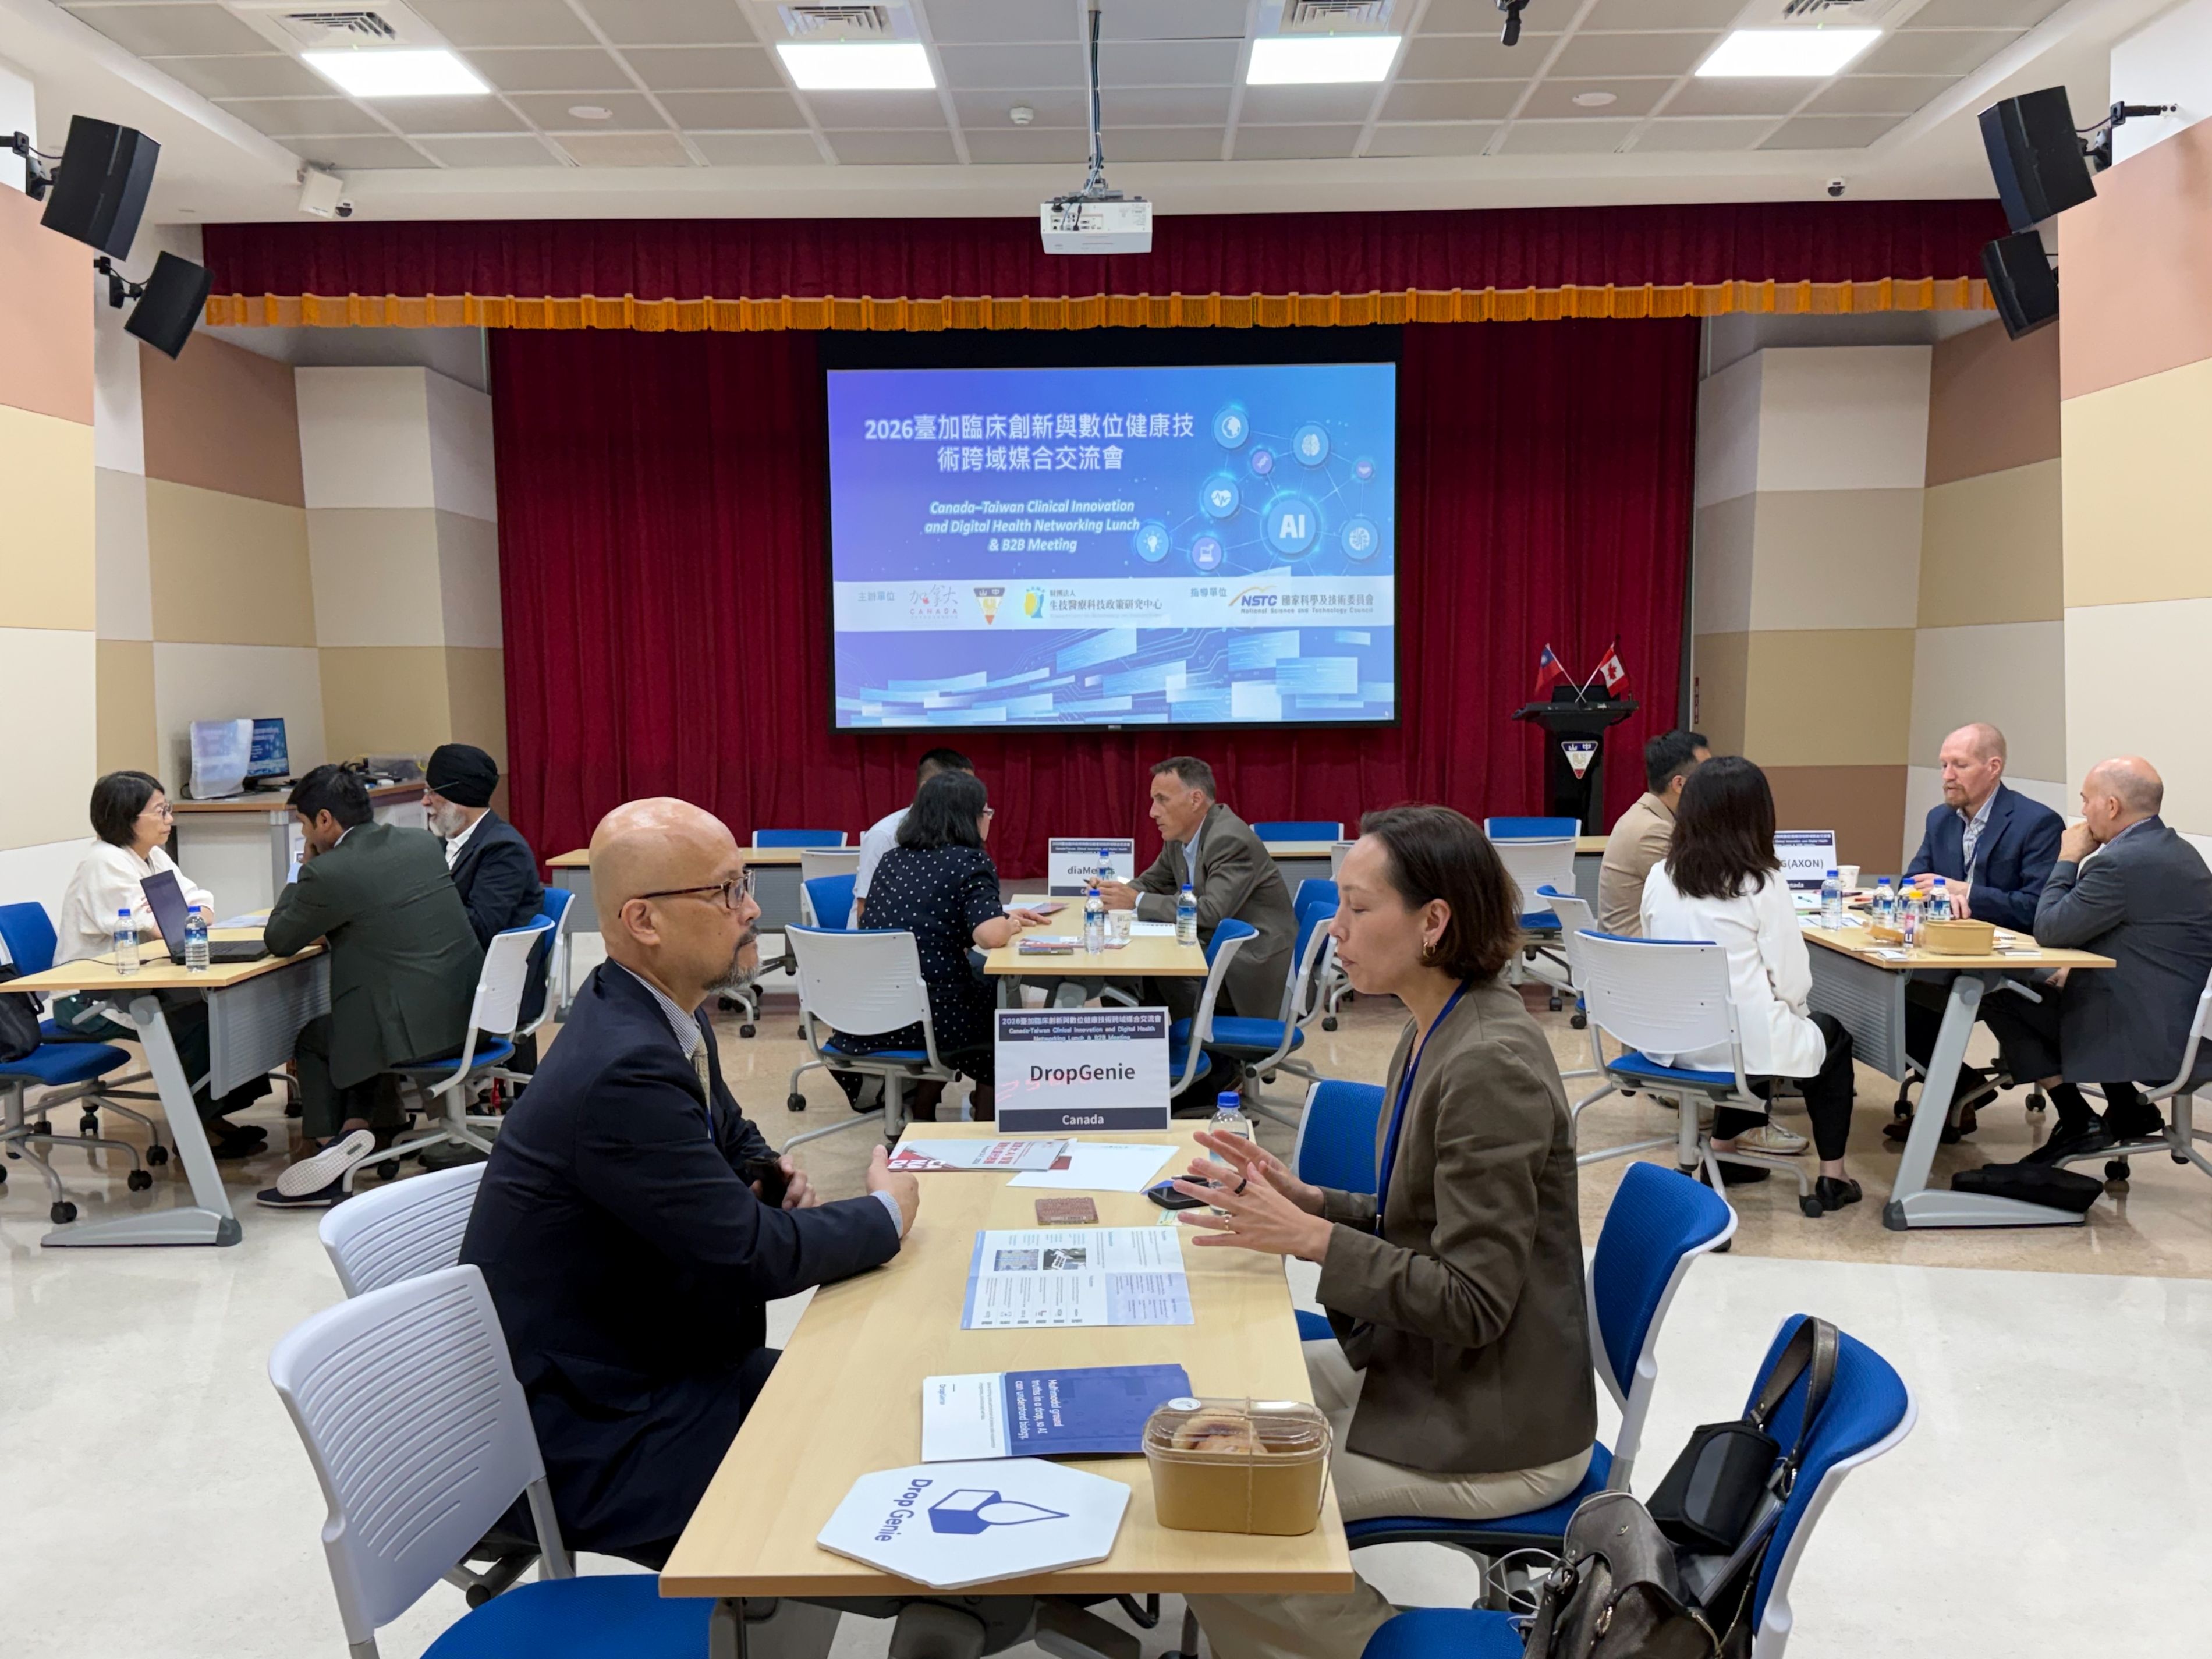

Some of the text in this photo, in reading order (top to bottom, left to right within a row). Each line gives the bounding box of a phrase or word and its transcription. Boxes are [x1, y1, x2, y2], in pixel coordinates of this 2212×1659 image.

[864, 413, 1194, 441] 2026臺加臨床創新與數位健康技
[938, 445, 1123, 472] 術跨域媒合交流會
[1027, 500, 1069, 513] Clinical
[1072, 499, 1134, 513] Innovation
[924, 518, 1140, 535] and Digital Health Networking Lunch
[1279, 515, 1305, 538] AI
[988, 538, 1077, 552] & B2B Meeting
[1049, 598, 1163, 611] 生技醫療科技政策研究中心
[1241, 595, 1277, 607] NSTC
[1281, 594, 1373, 607] 國家科學及技術委員會
[1030, 1062, 1135, 1085] DropGenie
[1062, 1114, 1104, 1125] Canada
[1015, 1381, 1023, 1391] can
[1031, 1380, 1043, 1395] truths
[1016, 1392, 1029, 1420] understand
[1048, 1379, 1064, 1427] Multimodal ground
